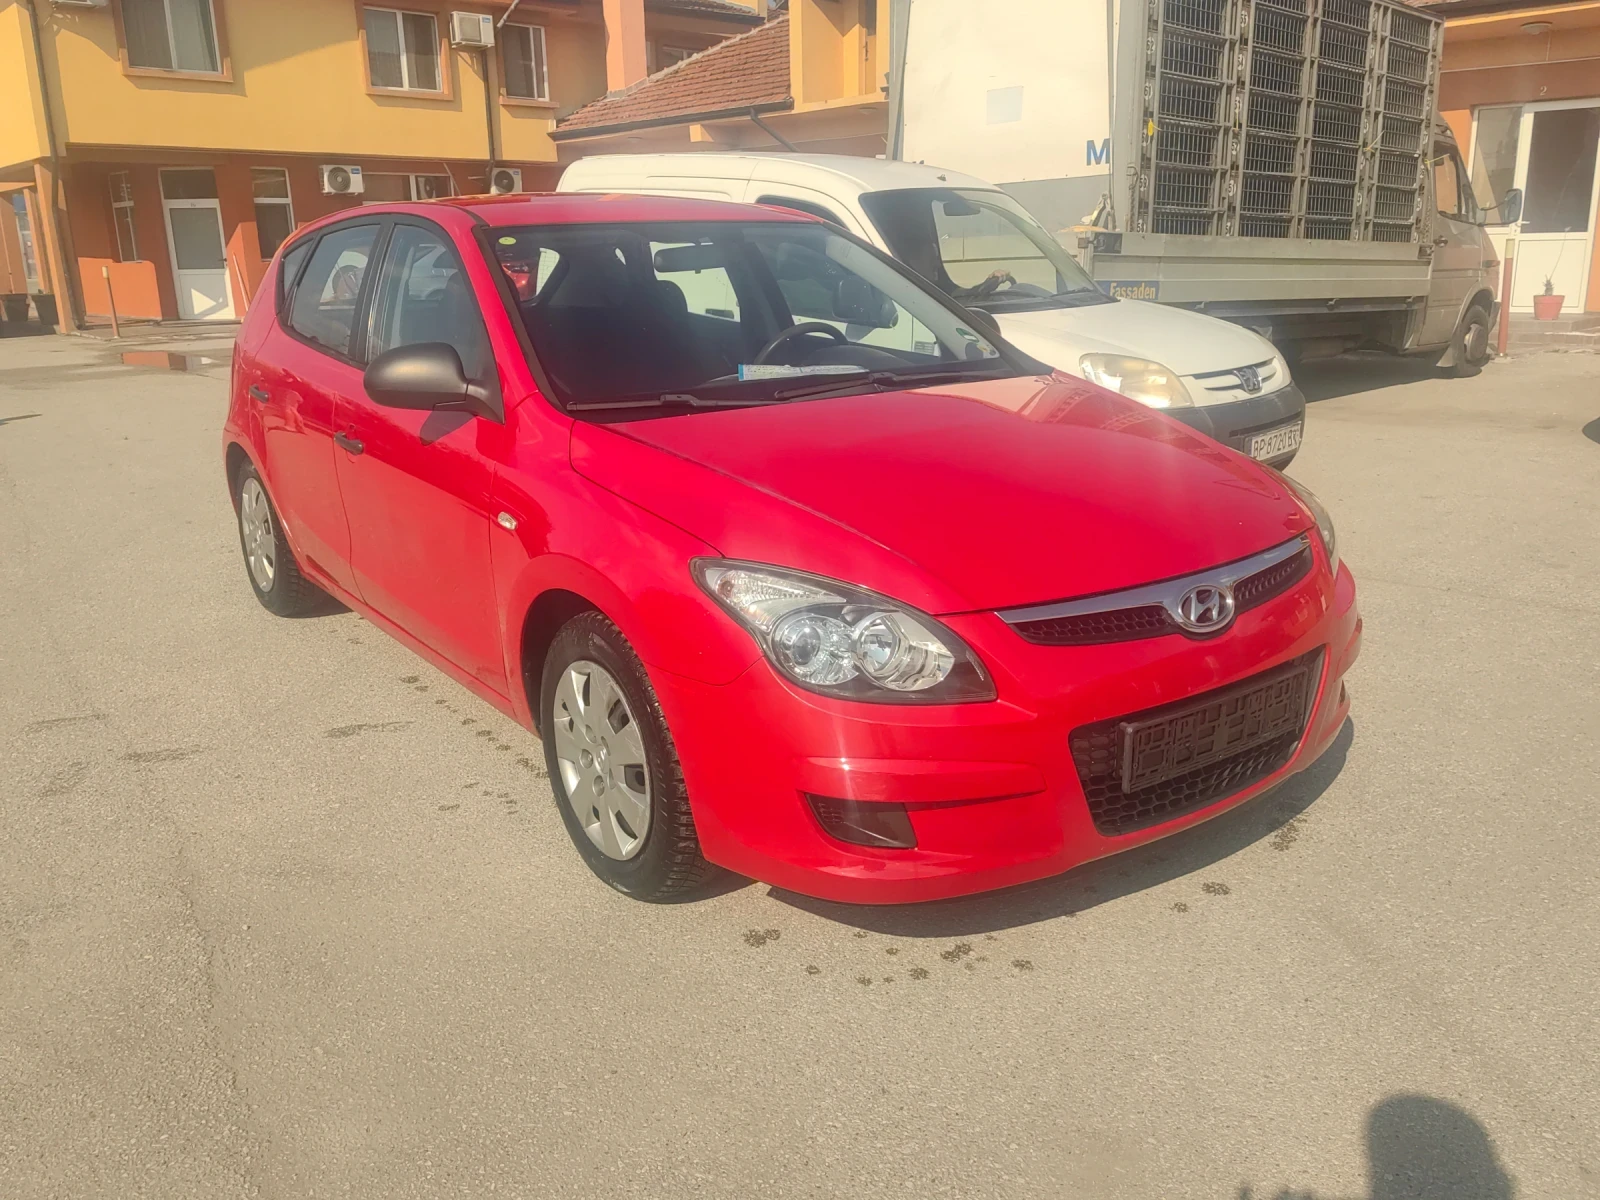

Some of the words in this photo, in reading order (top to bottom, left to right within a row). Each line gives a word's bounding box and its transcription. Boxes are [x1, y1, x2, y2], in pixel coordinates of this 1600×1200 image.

[1540, 85, 1547, 96] 2
[1086, 138, 1110, 166] M
[1109, 282, 1156, 299] Fassaden
